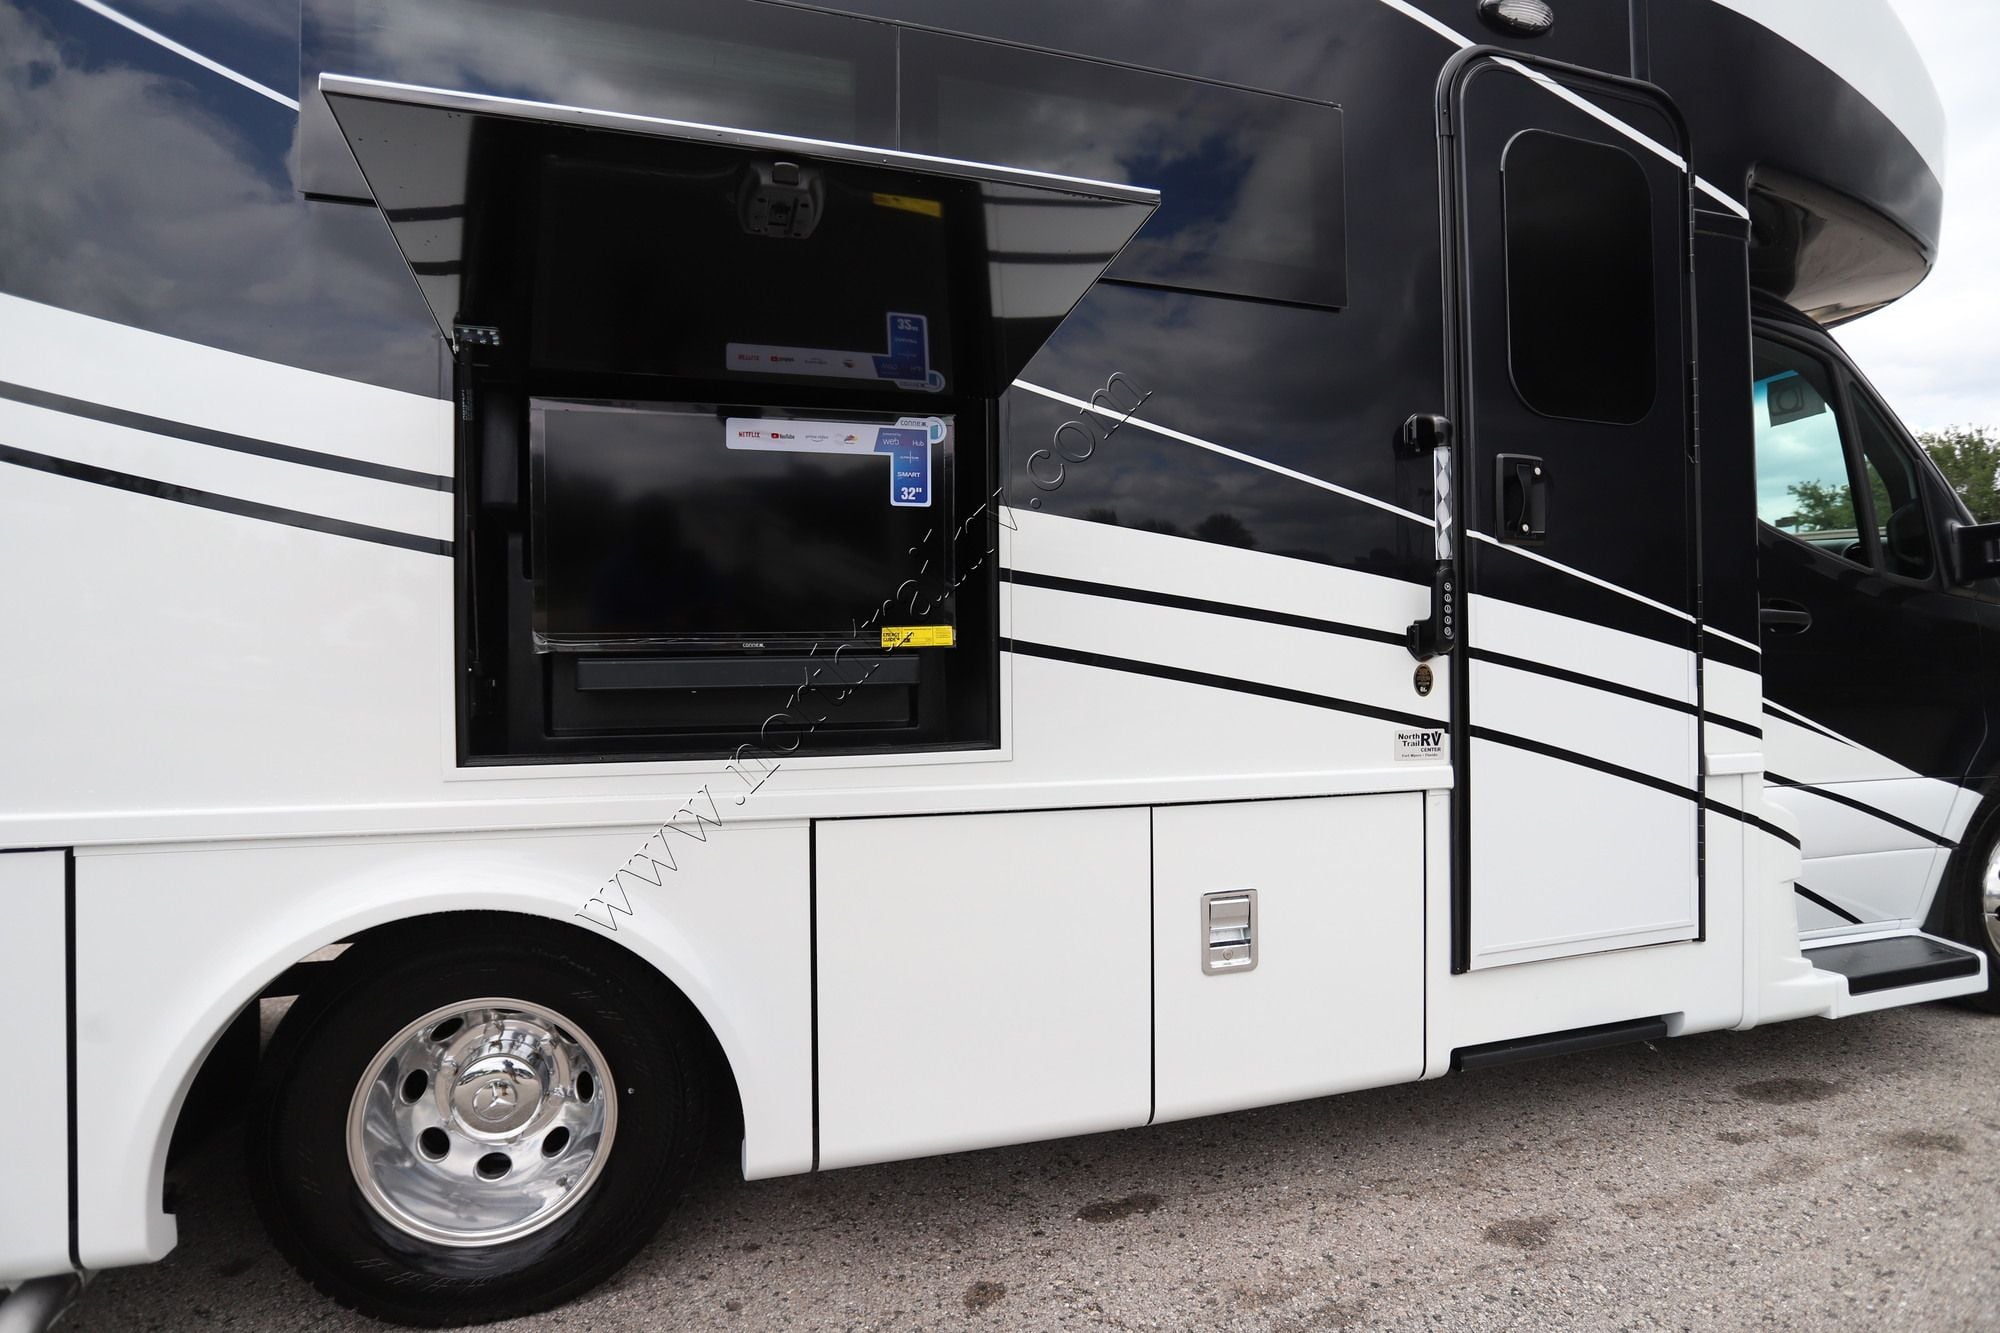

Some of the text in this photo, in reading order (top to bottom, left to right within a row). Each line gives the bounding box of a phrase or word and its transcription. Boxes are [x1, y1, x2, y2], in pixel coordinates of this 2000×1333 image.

[738, 431, 761, 439] NETFLIX
[901, 487, 922, 500] 32"
[1420, 731, 1441, 746] RV
